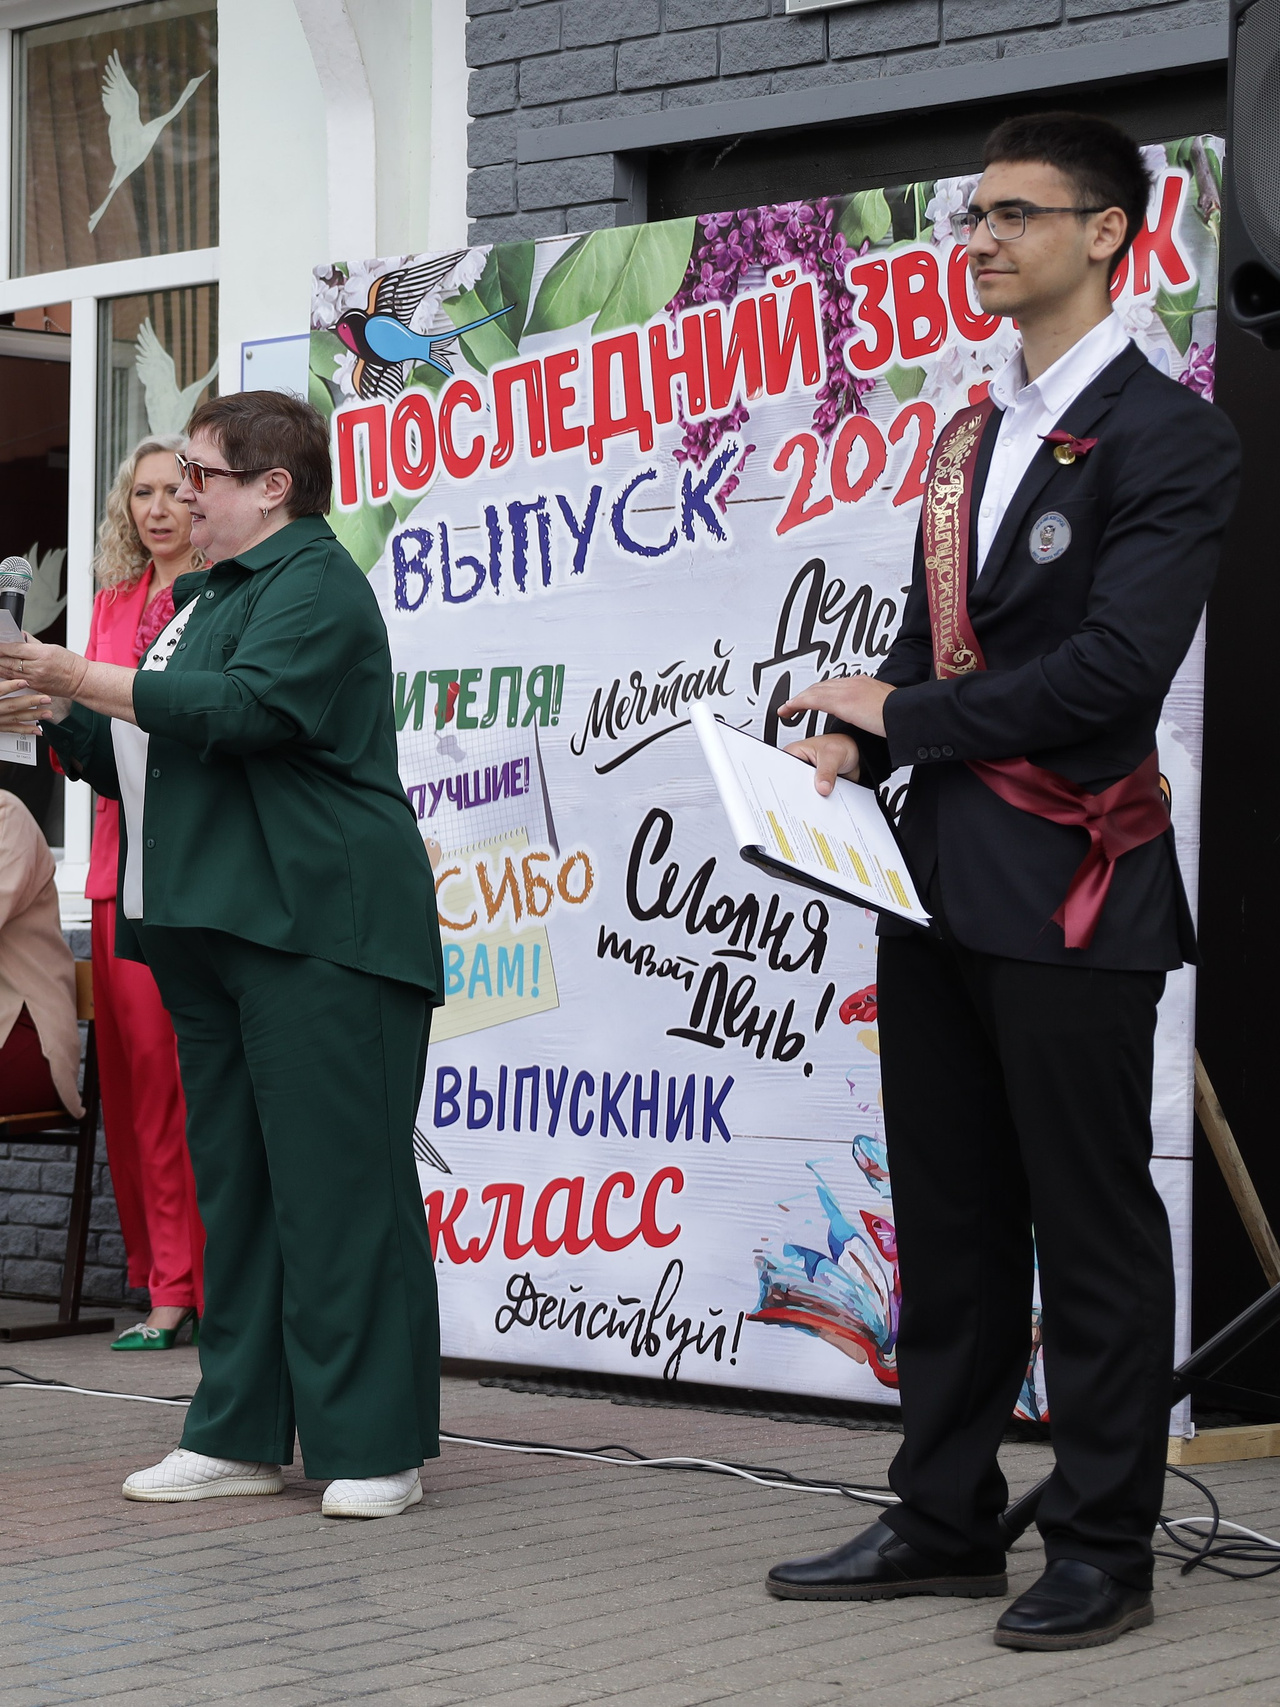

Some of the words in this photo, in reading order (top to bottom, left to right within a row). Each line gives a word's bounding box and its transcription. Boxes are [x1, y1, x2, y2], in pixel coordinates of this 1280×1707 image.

[336, 271, 822, 506] ПОСЛЕДНИЙ
[848, 176, 1190, 371] ЗВОК
[393, 440, 738, 612] ВЫПУСК
[774, 381, 991, 536] 202
[753, 557, 911, 696] Дела
[392, 664, 565, 731] ИТЕЛЯ!
[570, 639, 735, 756] Мечтай
[626, 808, 829, 974] Сегодня
[444, 943, 541, 999] ВАМ!
[597, 925, 700, 991] твой
[666, 961, 835, 1077] День!
[434, 1064, 735, 1144] ВЫПУСКНИК
[495, 1260, 746, 1380] Действуй!
